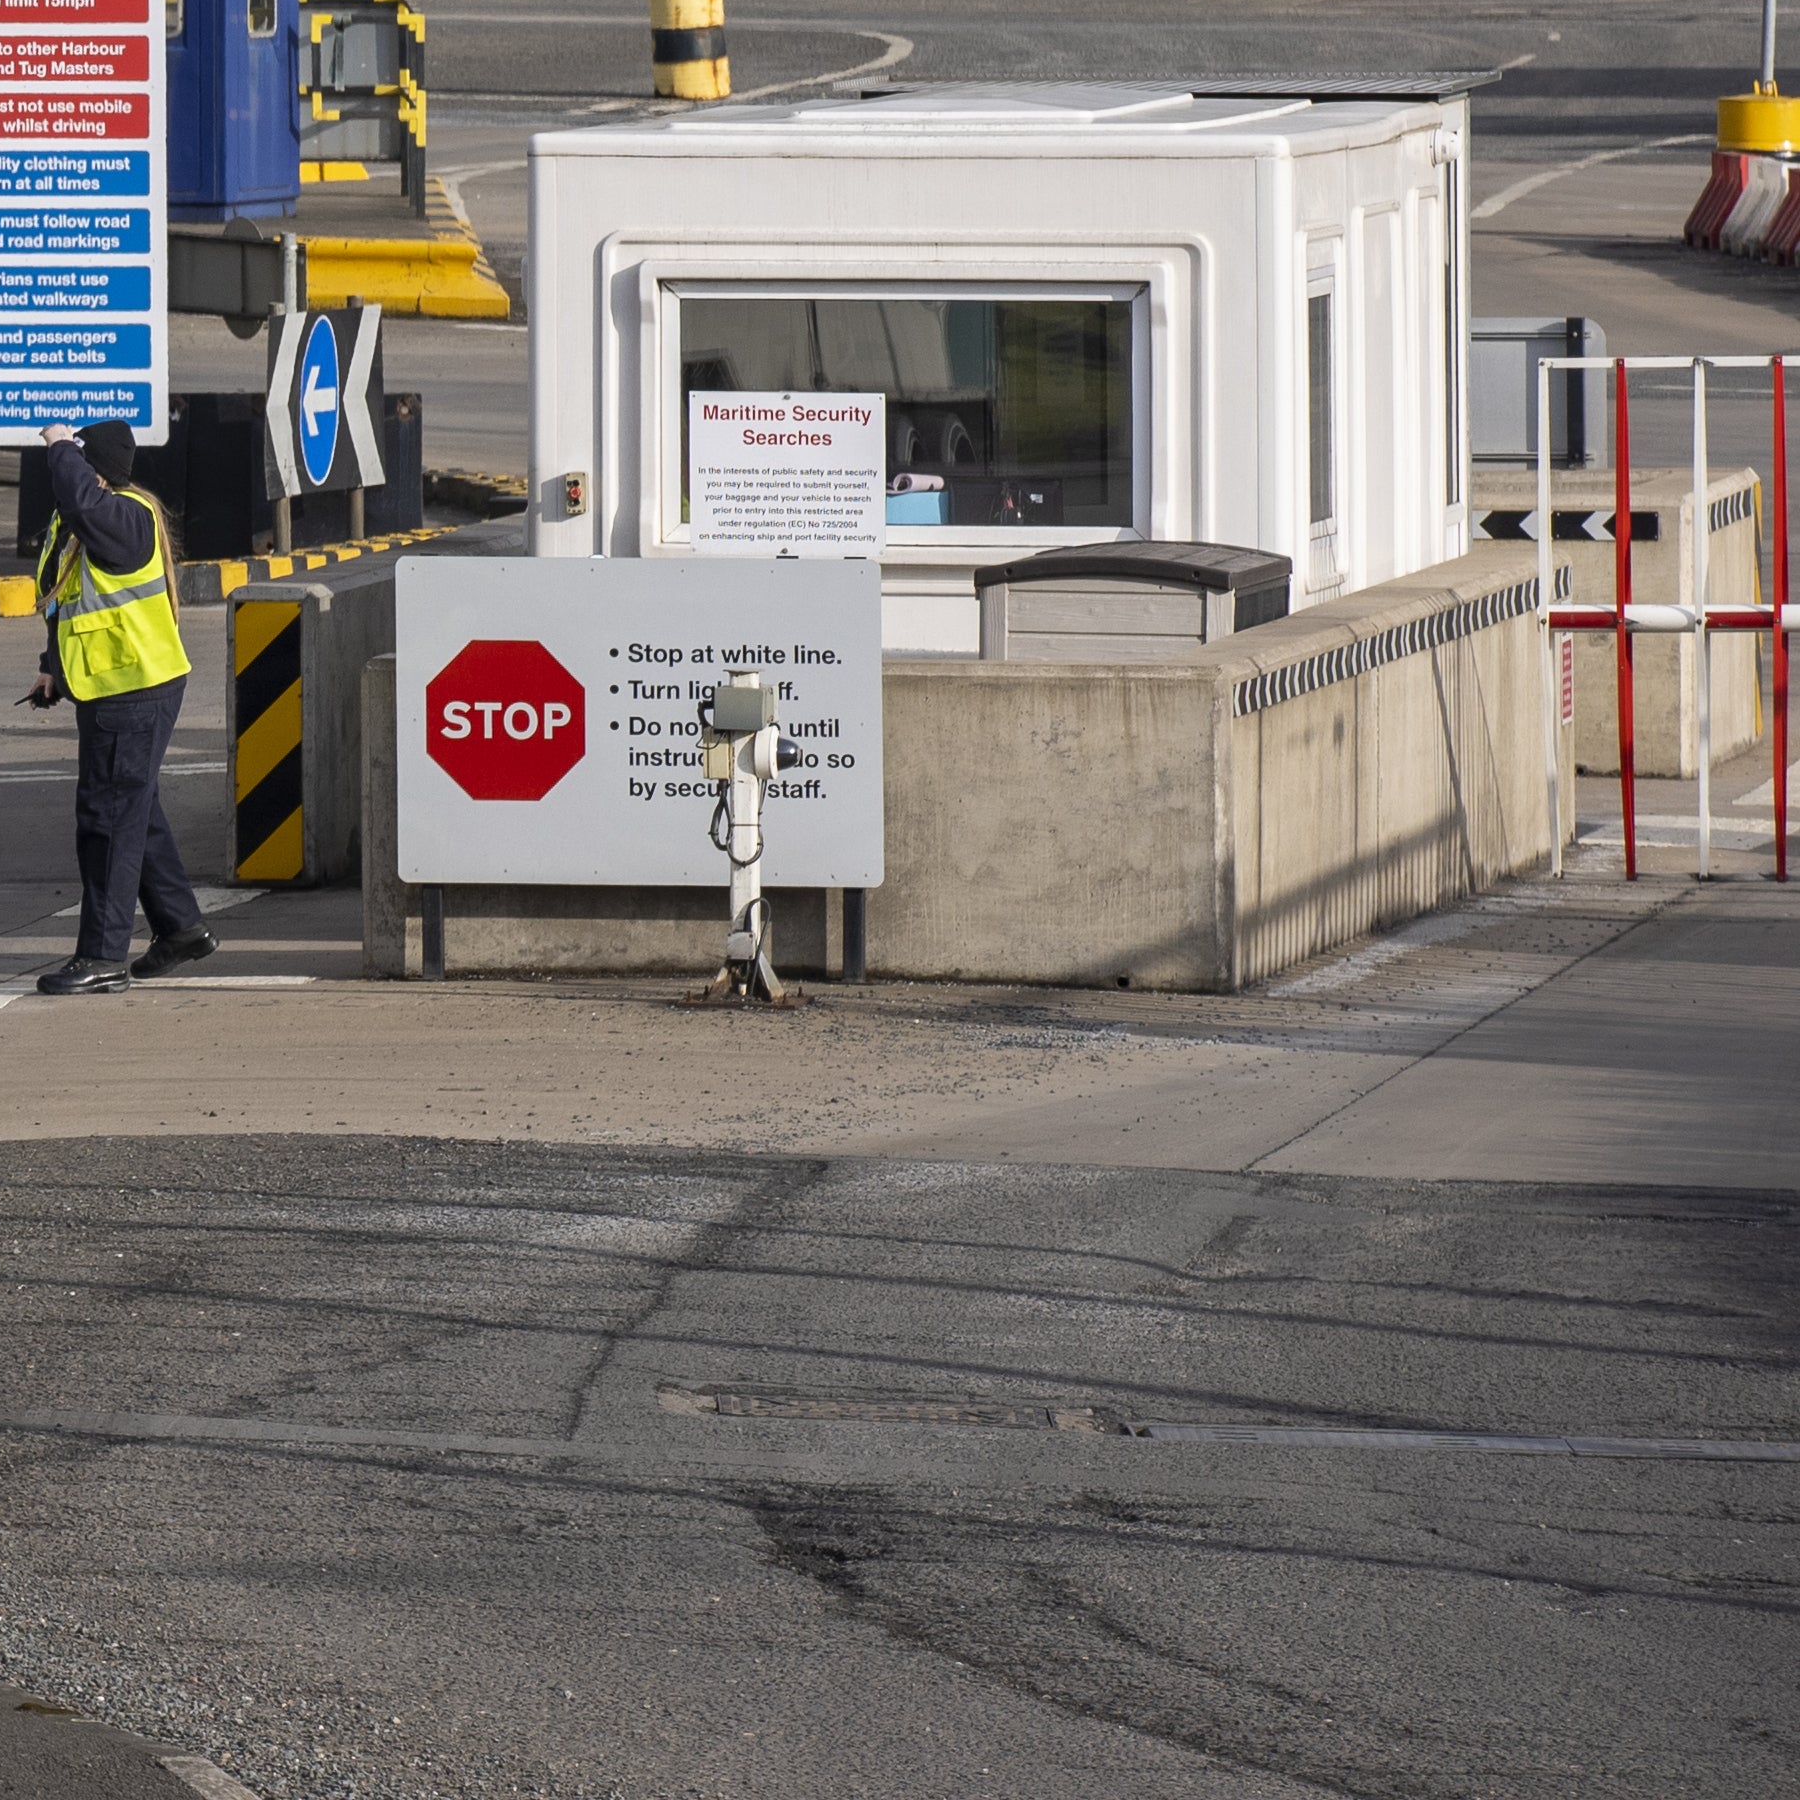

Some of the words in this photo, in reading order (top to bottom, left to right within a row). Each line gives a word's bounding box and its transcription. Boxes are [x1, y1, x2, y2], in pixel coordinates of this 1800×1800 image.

[16, 41, 58, 56] other
[62, 41, 126, 56] Harbour
[18, 60, 47, 78] Tug
[51, 61, 114, 75] Masters
[18, 99, 44, 113] not
[47, 102, 75, 113] use
[79, 99, 132, 114] mobile
[2, 118, 49, 133] whilst
[52, 118, 106, 136] driving
[23, 156, 87, 174] clothing
[91, 157, 130, 171] must
[15, 176, 32, 190] at
[35, 176, 53, 190] all
[56, 176, 100, 190] times
[0, 214, 40, 228] must
[42, 214, 90, 228] follow
[94, 214, 130, 228] road
[8, 233, 44, 248] road
[47, 234, 120, 251] markings
[37, 272, 77, 286] must
[80, 274, 109, 286] use
[32, 291, 108, 309] walkways
[26, 332, 117, 347] passengers
[30, 349, 64, 364] seat
[67, 348, 106, 363] belts
[703, 404, 786, 421] Maritime
[792, 405, 872, 426] Security
[743, 429, 832, 446] Searches
[628, 643, 683, 668] Stop
[691, 645, 714, 664] at
[721, 644, 786, 664] white
[794, 645, 842, 665] line.
[628, 680, 680, 700] Turn
[440, 701, 571, 740] STOP
[629, 716, 662, 736] Do
[789, 718, 839, 738] until
[827, 754, 855, 768] so
[629, 777, 657, 801] by
[768, 779, 827, 799] staff.
